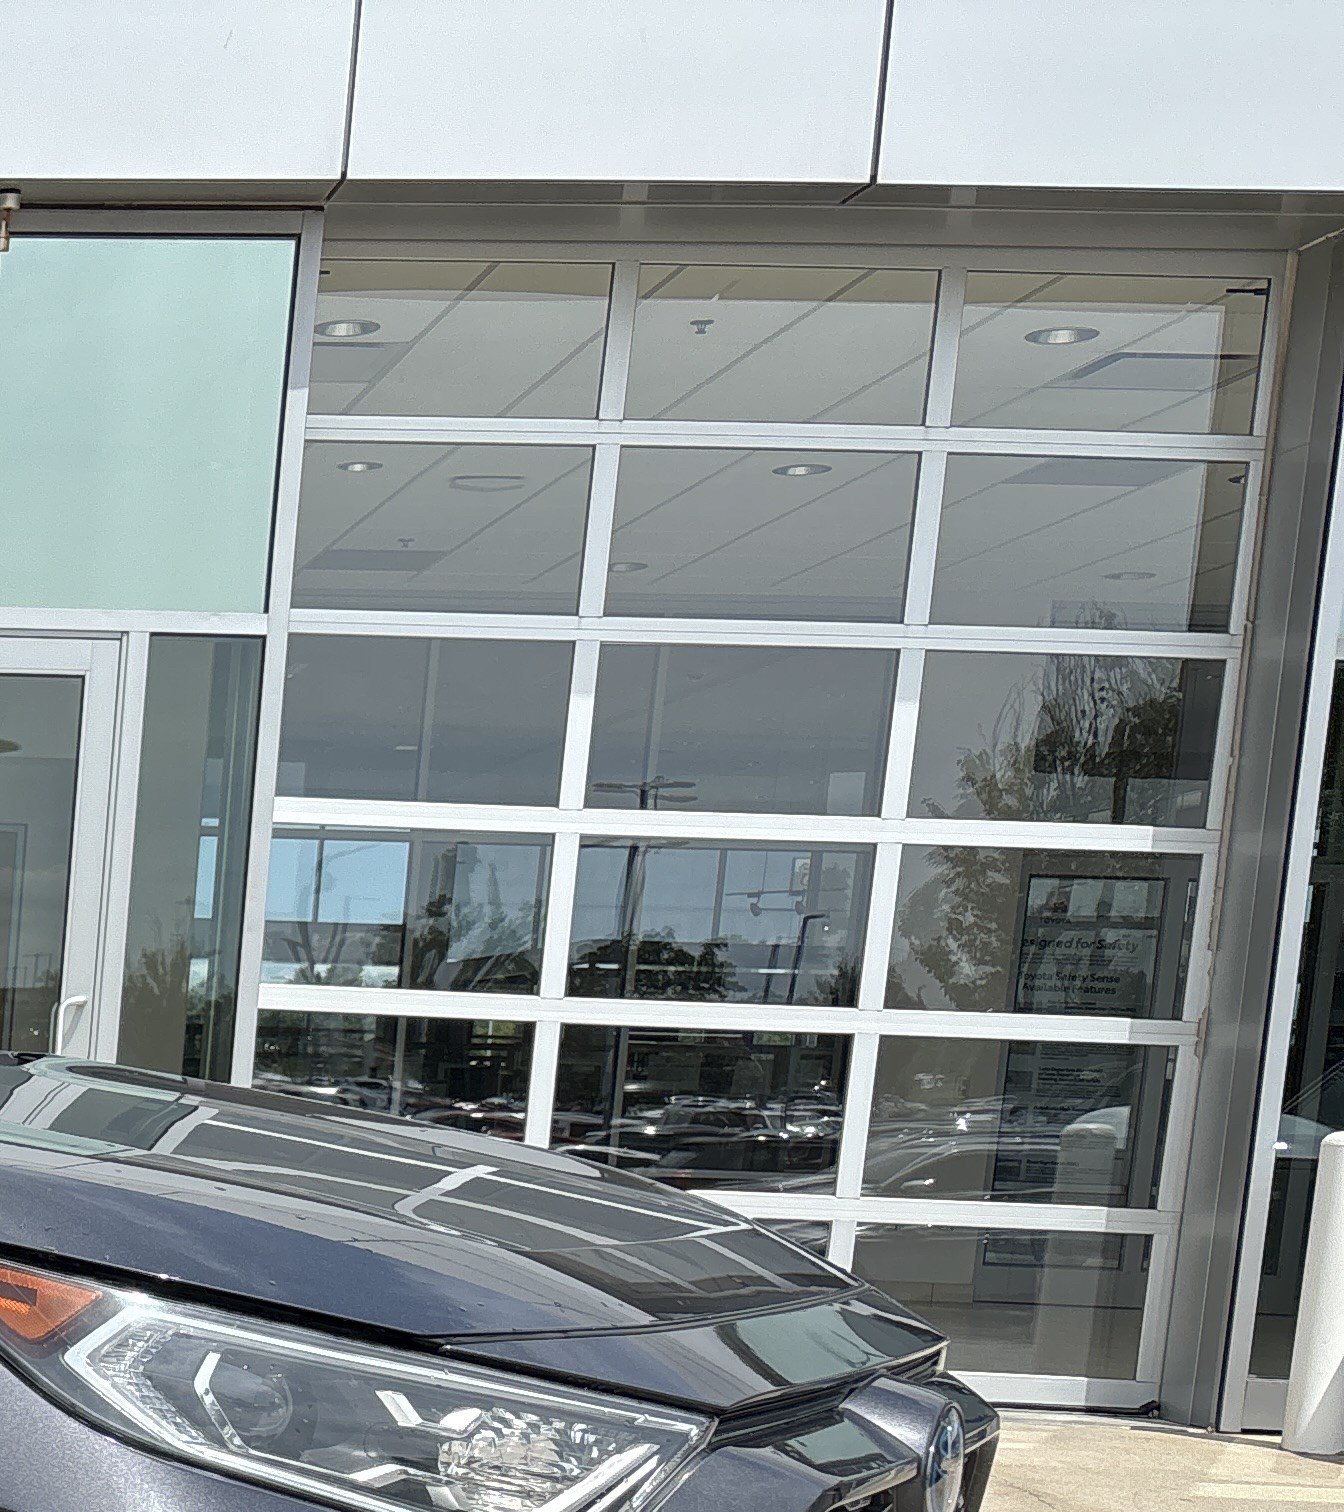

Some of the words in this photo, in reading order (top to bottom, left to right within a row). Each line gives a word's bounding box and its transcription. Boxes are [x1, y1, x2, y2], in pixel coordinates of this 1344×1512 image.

[1039, 916, 1071, 924] TOYOTA
[1023, 937, 1073, 950] esigned
[1076, 938, 1095, 950] for
[1096, 939, 1138, 953] Safety
[1056, 972, 1088, 983] Safety
[1090, 973, 1120, 983] Sense
[1023, 982, 1071, 991] Available
